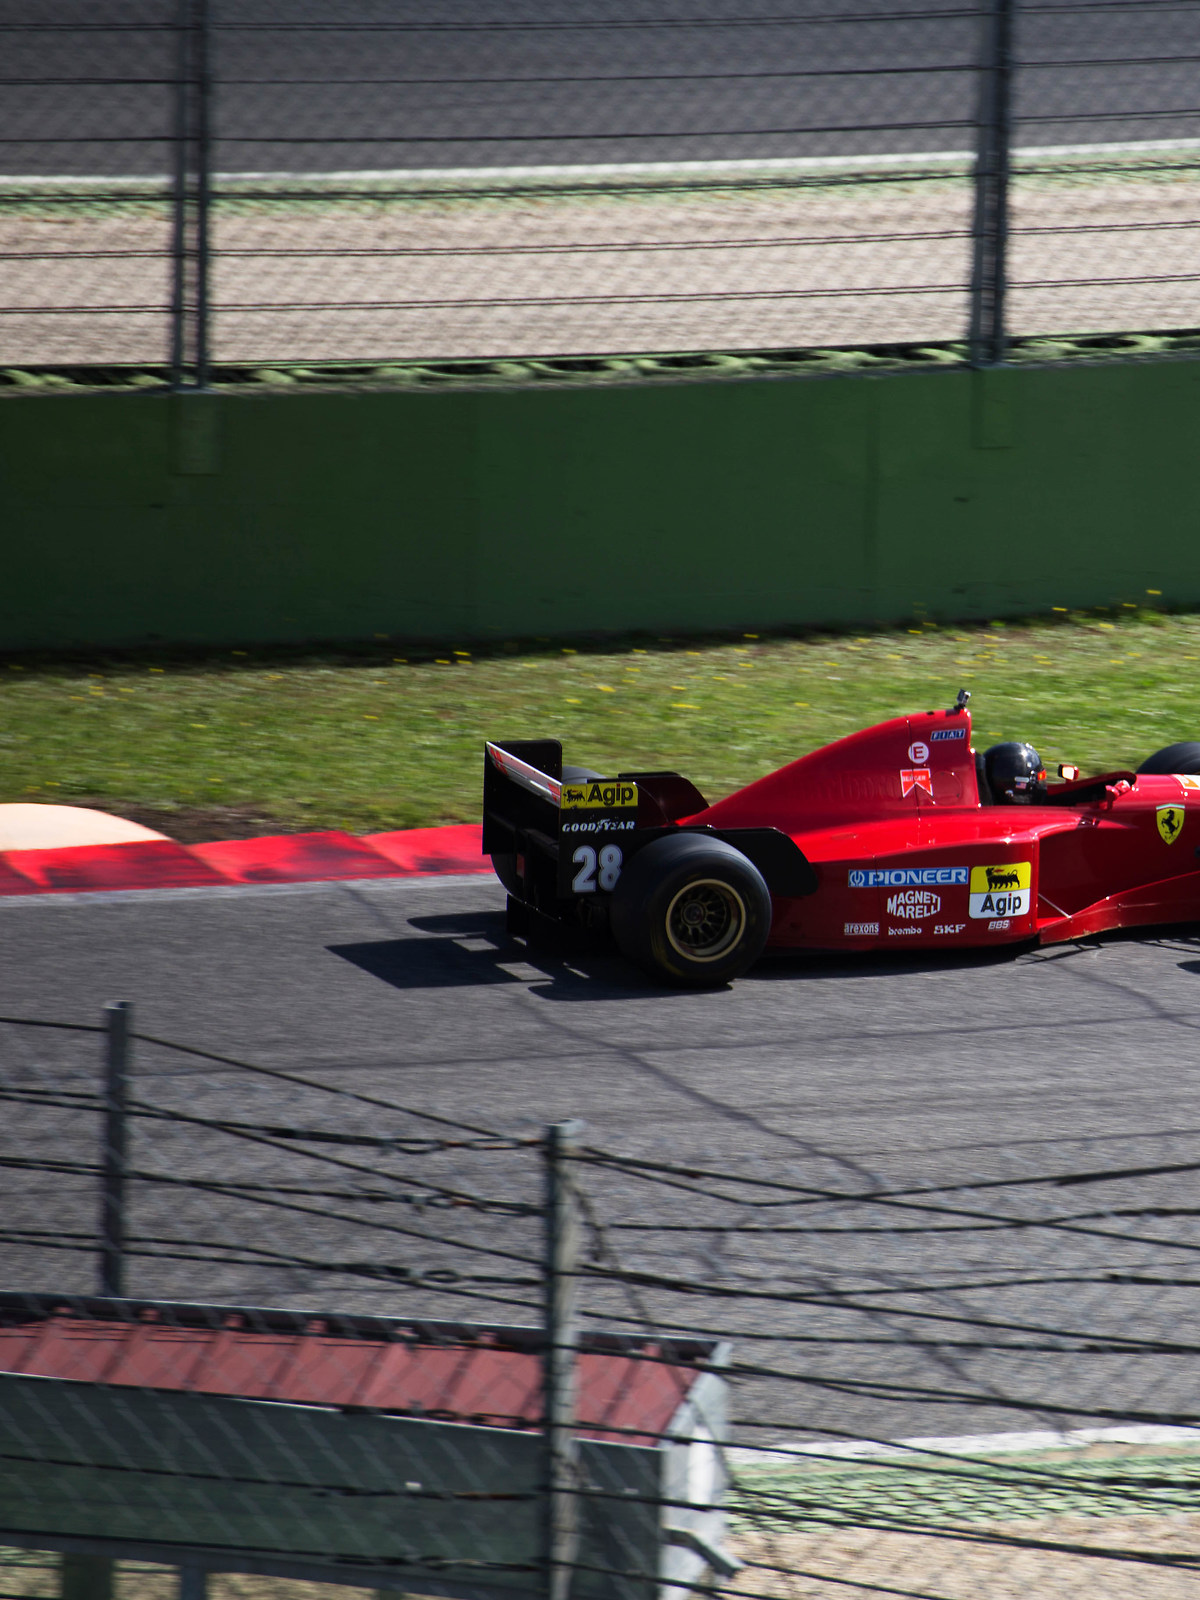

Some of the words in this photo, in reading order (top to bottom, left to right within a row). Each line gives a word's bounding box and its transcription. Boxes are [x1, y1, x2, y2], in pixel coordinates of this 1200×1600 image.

[932, 729, 965, 741] FIAT
[913, 746, 925, 760] E
[587, 783, 634, 807] Agip
[562, 819, 635, 833] GOODYEAR
[572, 844, 623, 893] 28
[868, 869, 967, 886] PIONEER
[887, 890, 941, 909] MAGNETI
[980, 893, 1022, 917] Agip
[887, 900, 941, 919] MARELLI
[844, 923, 880, 934] arexons
[933, 924, 966, 935] SKF
[988, 920, 1009, 930] BBS
